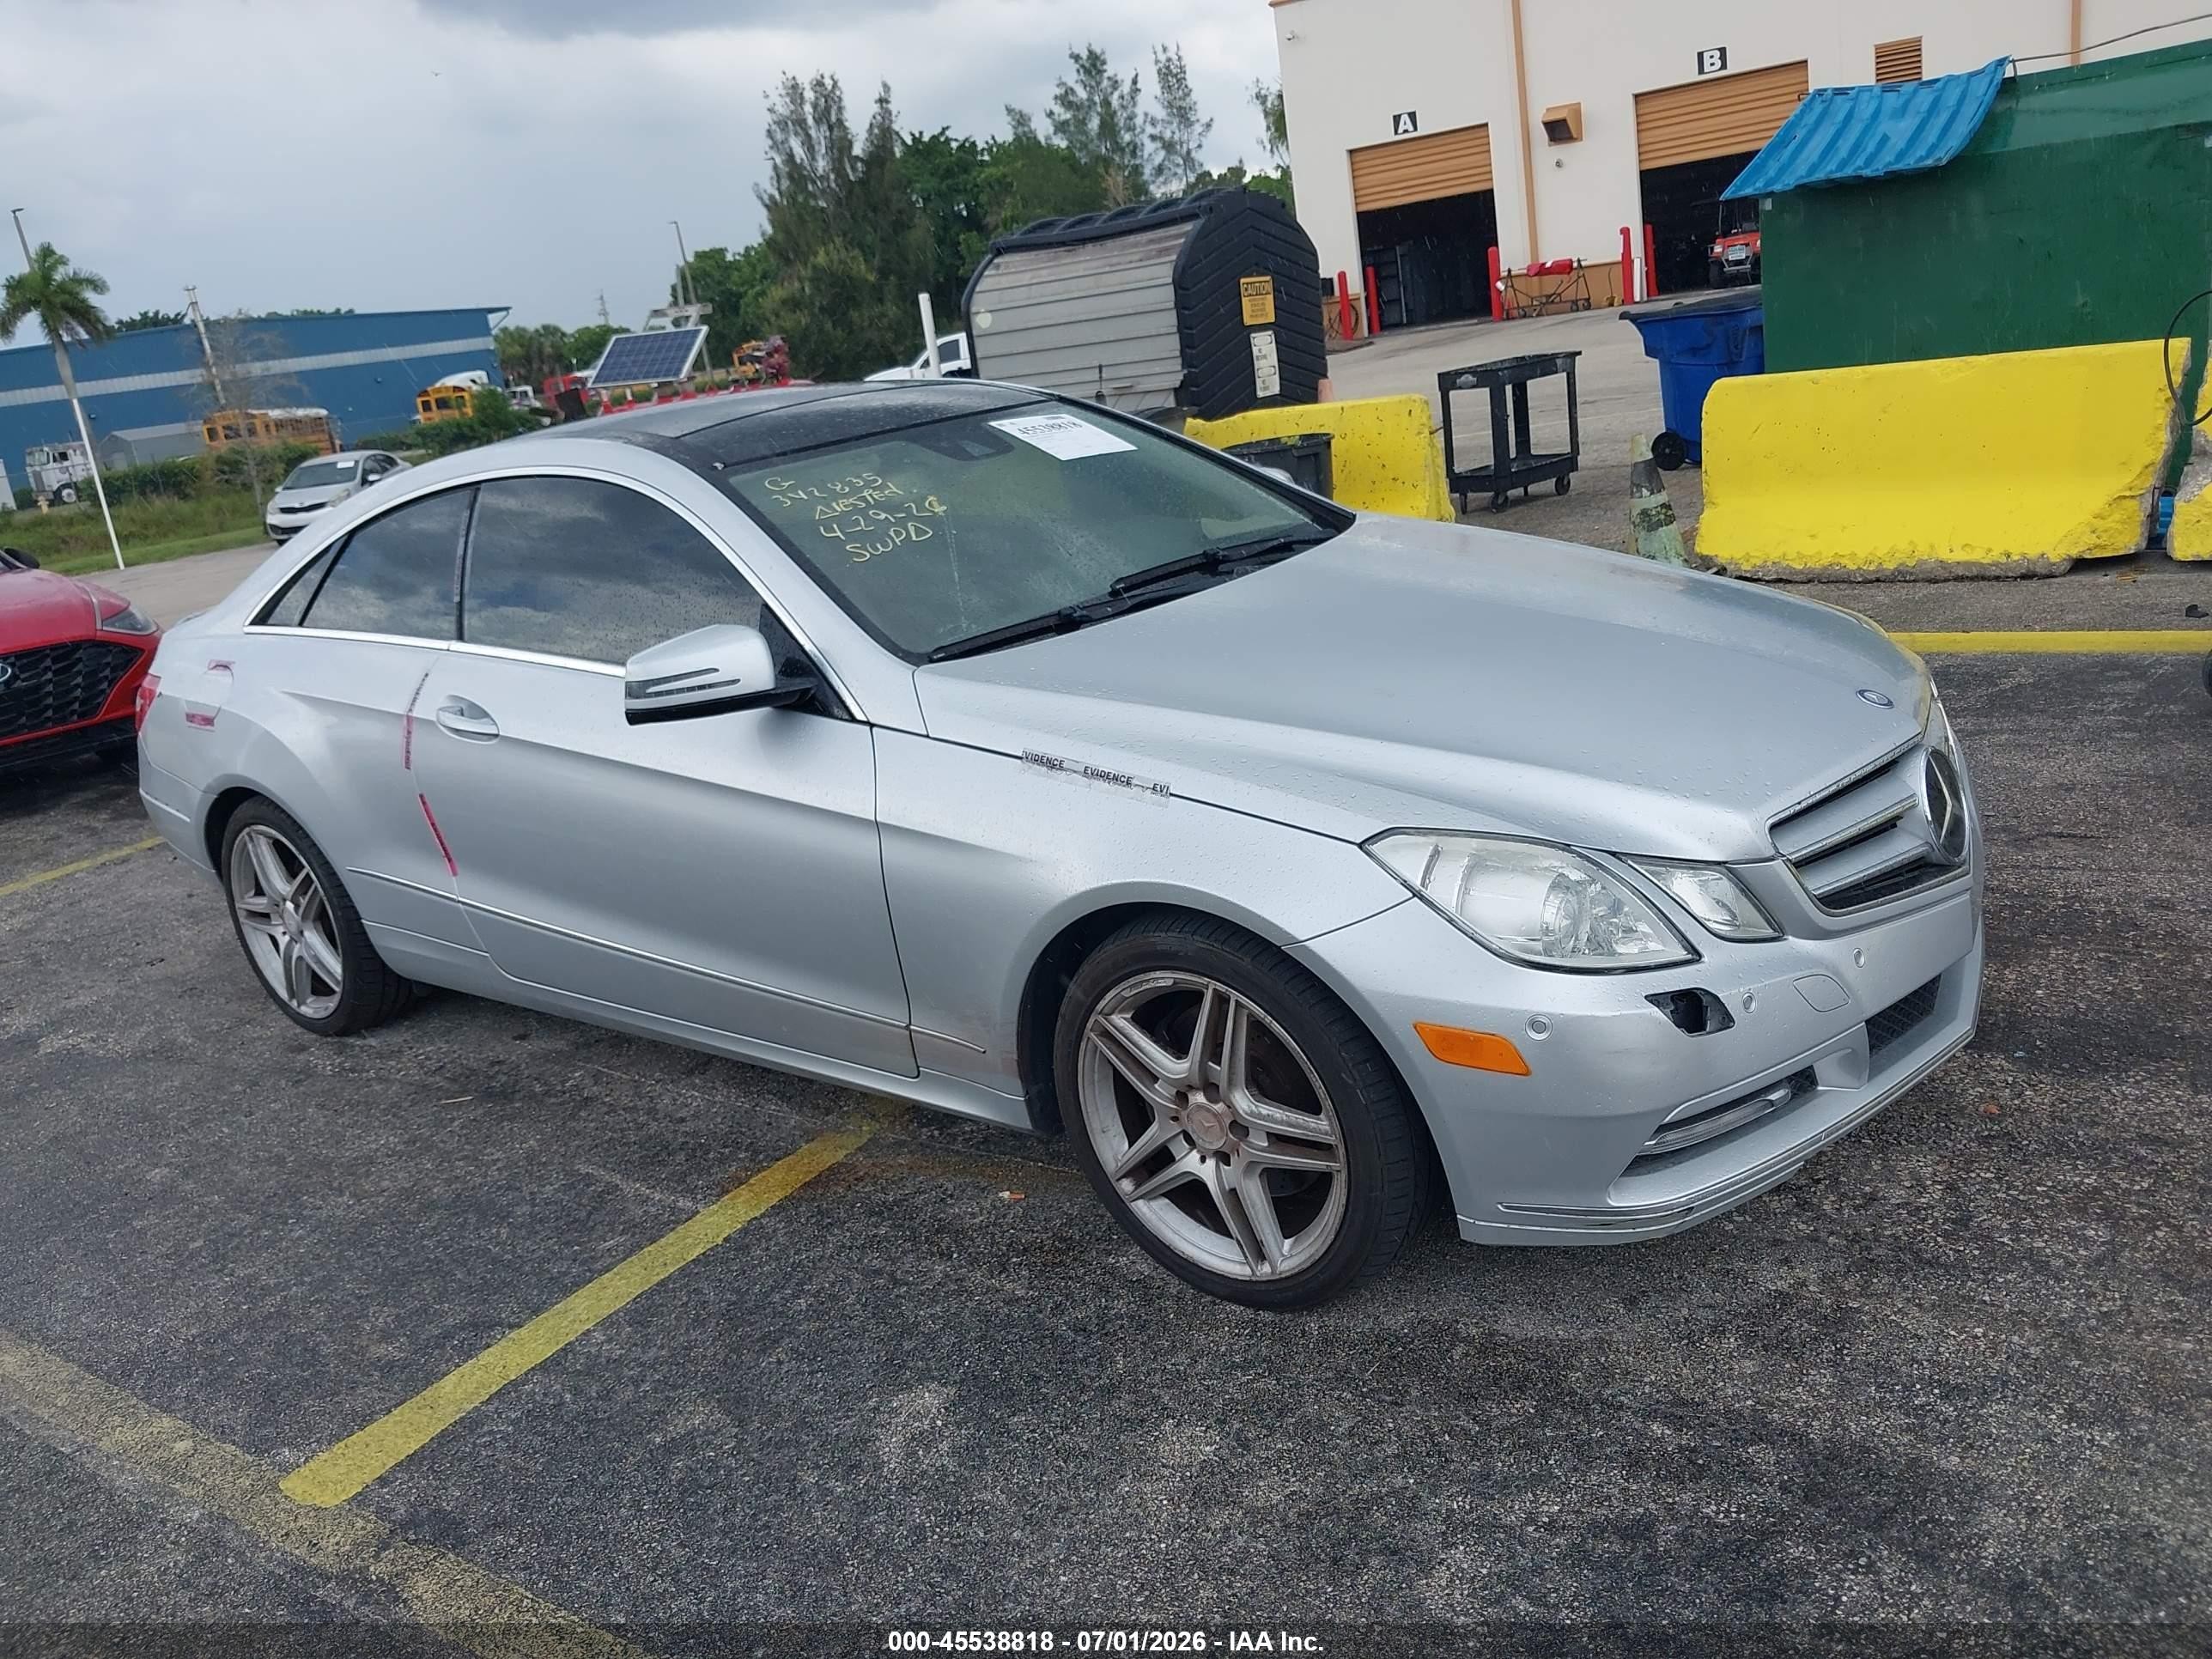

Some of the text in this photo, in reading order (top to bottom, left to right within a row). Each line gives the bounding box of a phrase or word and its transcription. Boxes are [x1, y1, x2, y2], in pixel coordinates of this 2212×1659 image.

[1703, 50, 1723, 73] B
[1397, 113, 1415, 134] A
[1243, 280, 1272, 296] CAUTION
[1083, 766, 1133, 786] EVIDENCE
